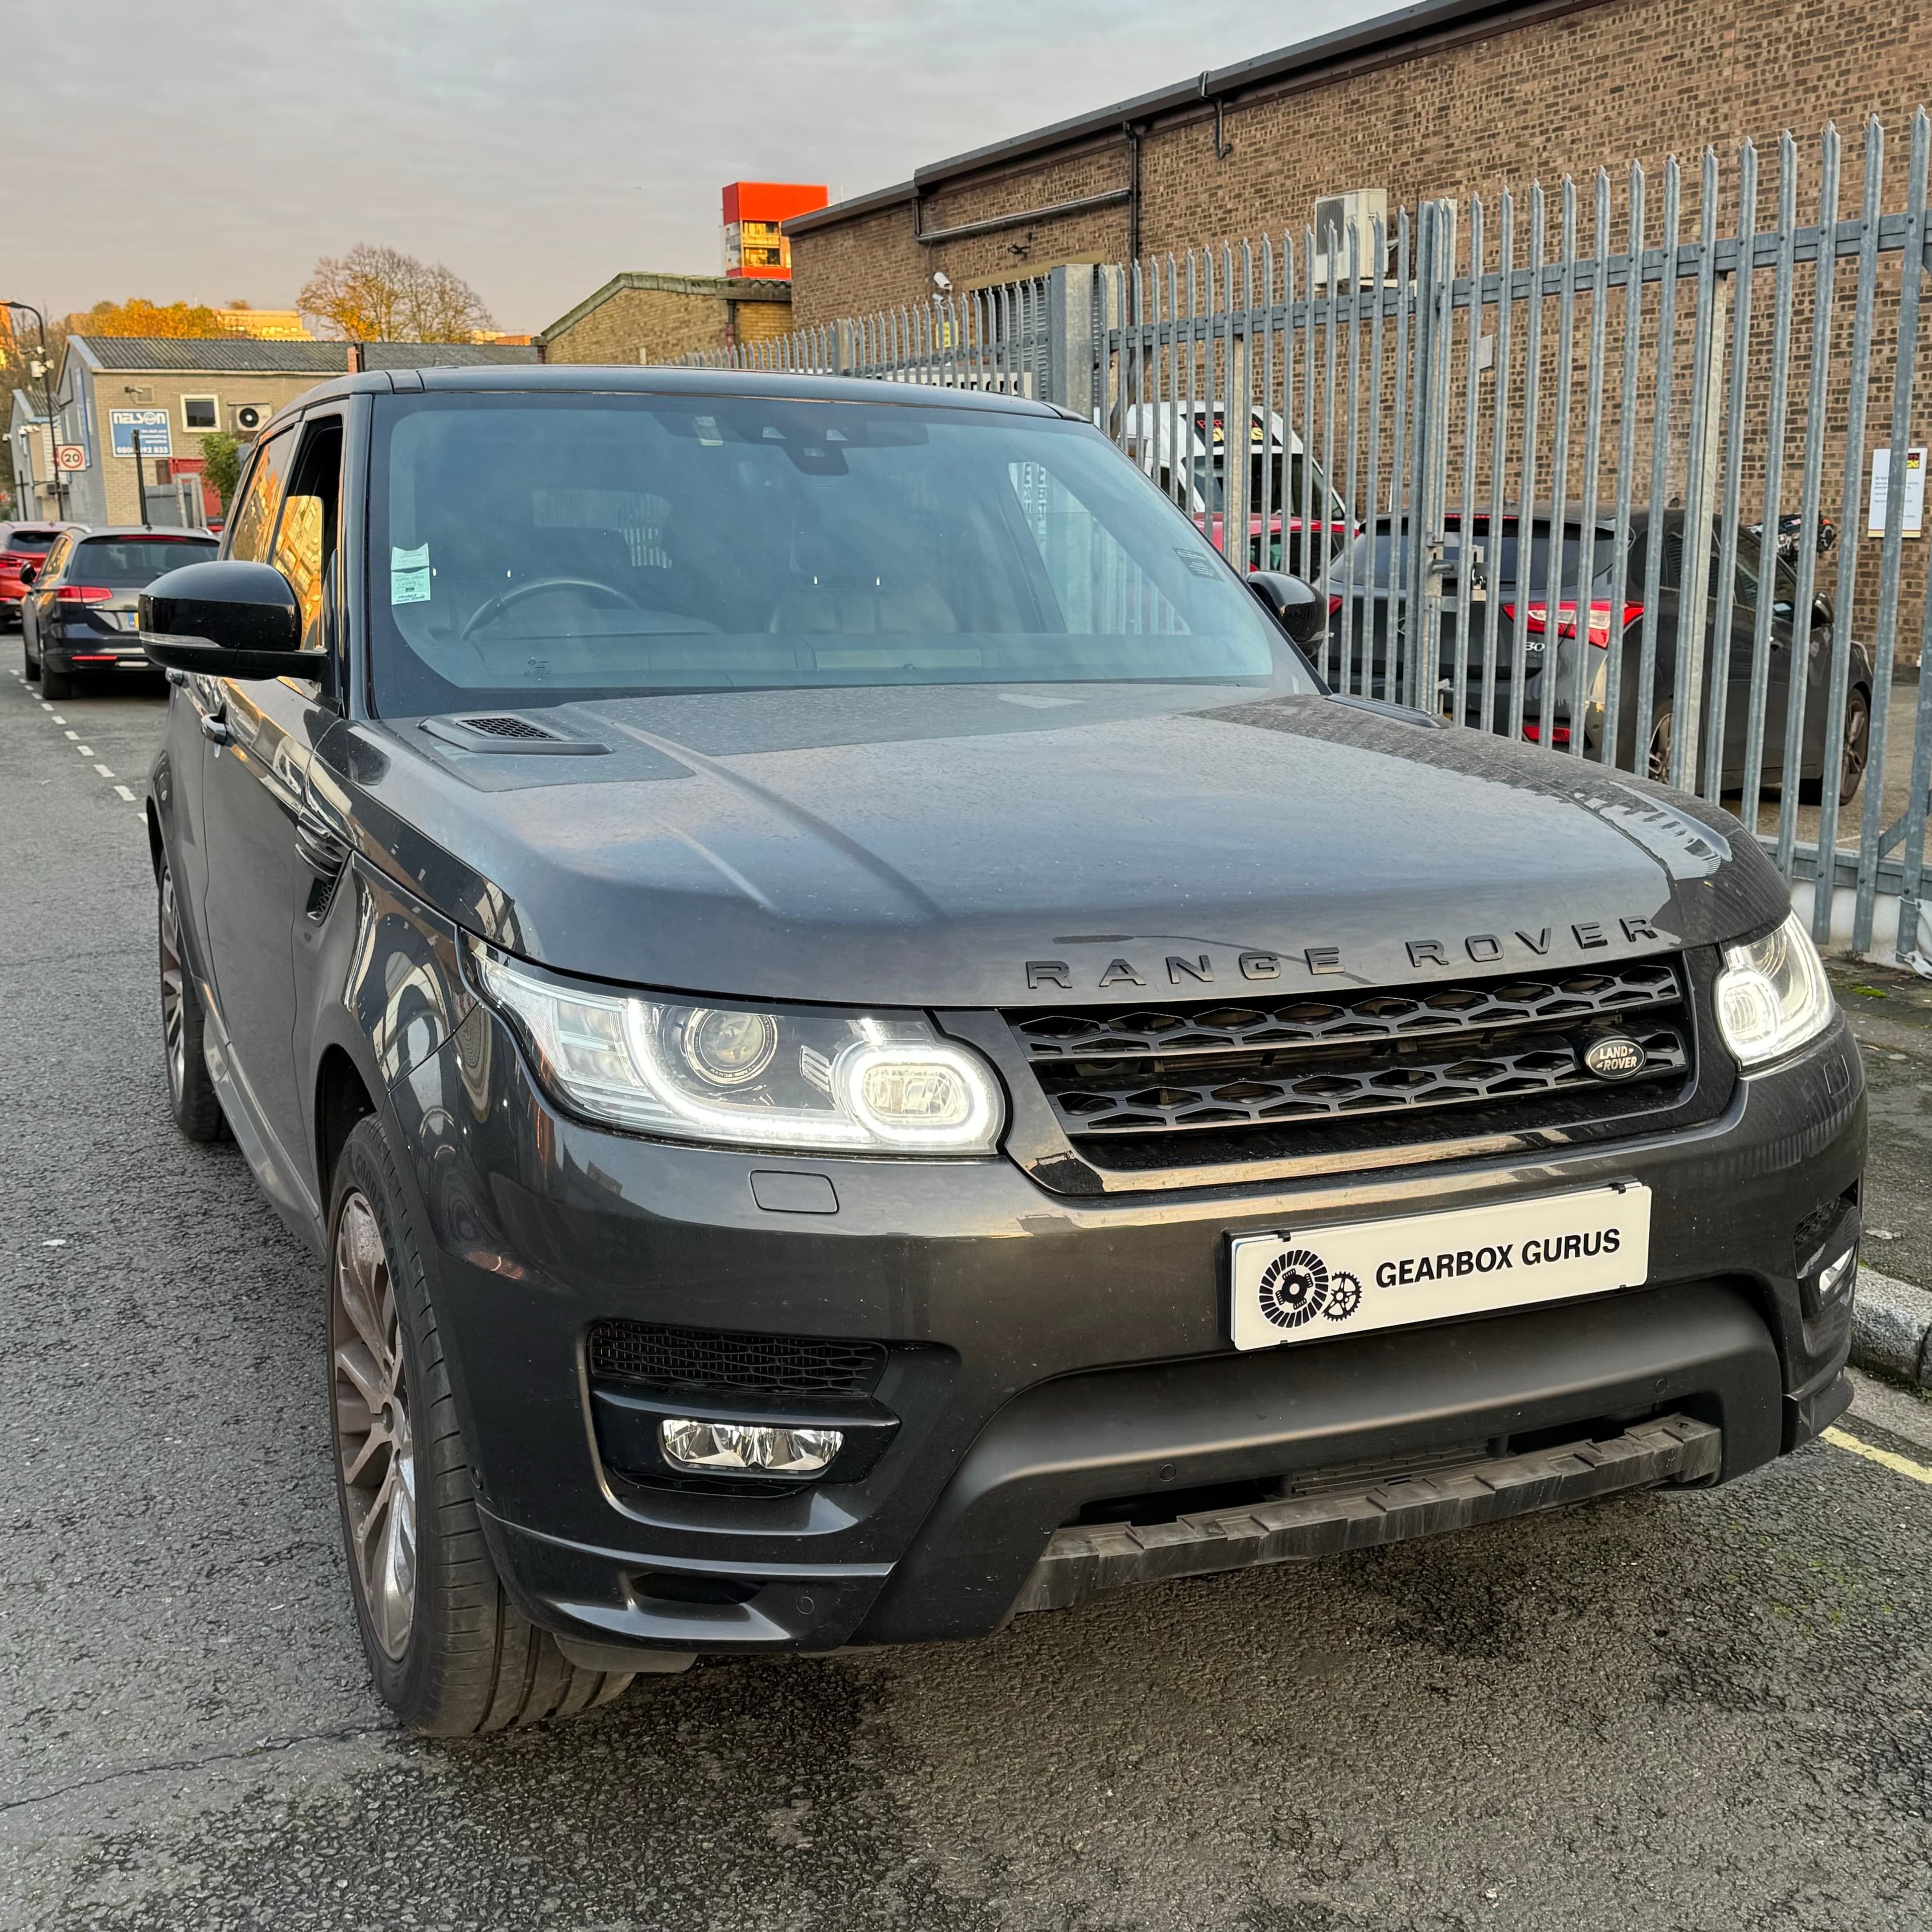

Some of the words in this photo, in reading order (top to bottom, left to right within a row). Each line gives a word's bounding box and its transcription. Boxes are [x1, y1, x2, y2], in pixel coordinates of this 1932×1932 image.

[64, 454, 79, 462] 20
[1526, 641, 1545, 652] 30
[1026, 946, 1346, 989] RANGE
[1405, 916, 1659, 967] ROVER
[1599, 1046, 1628, 1060] LAND
[1602, 1056, 1637, 1071] ROVER
[356, 1154, 400, 1289] GOODYEAR
[1376, 1244, 1514, 1289] GEARBOX
[1521, 1228, 1620, 1268] GURUS
